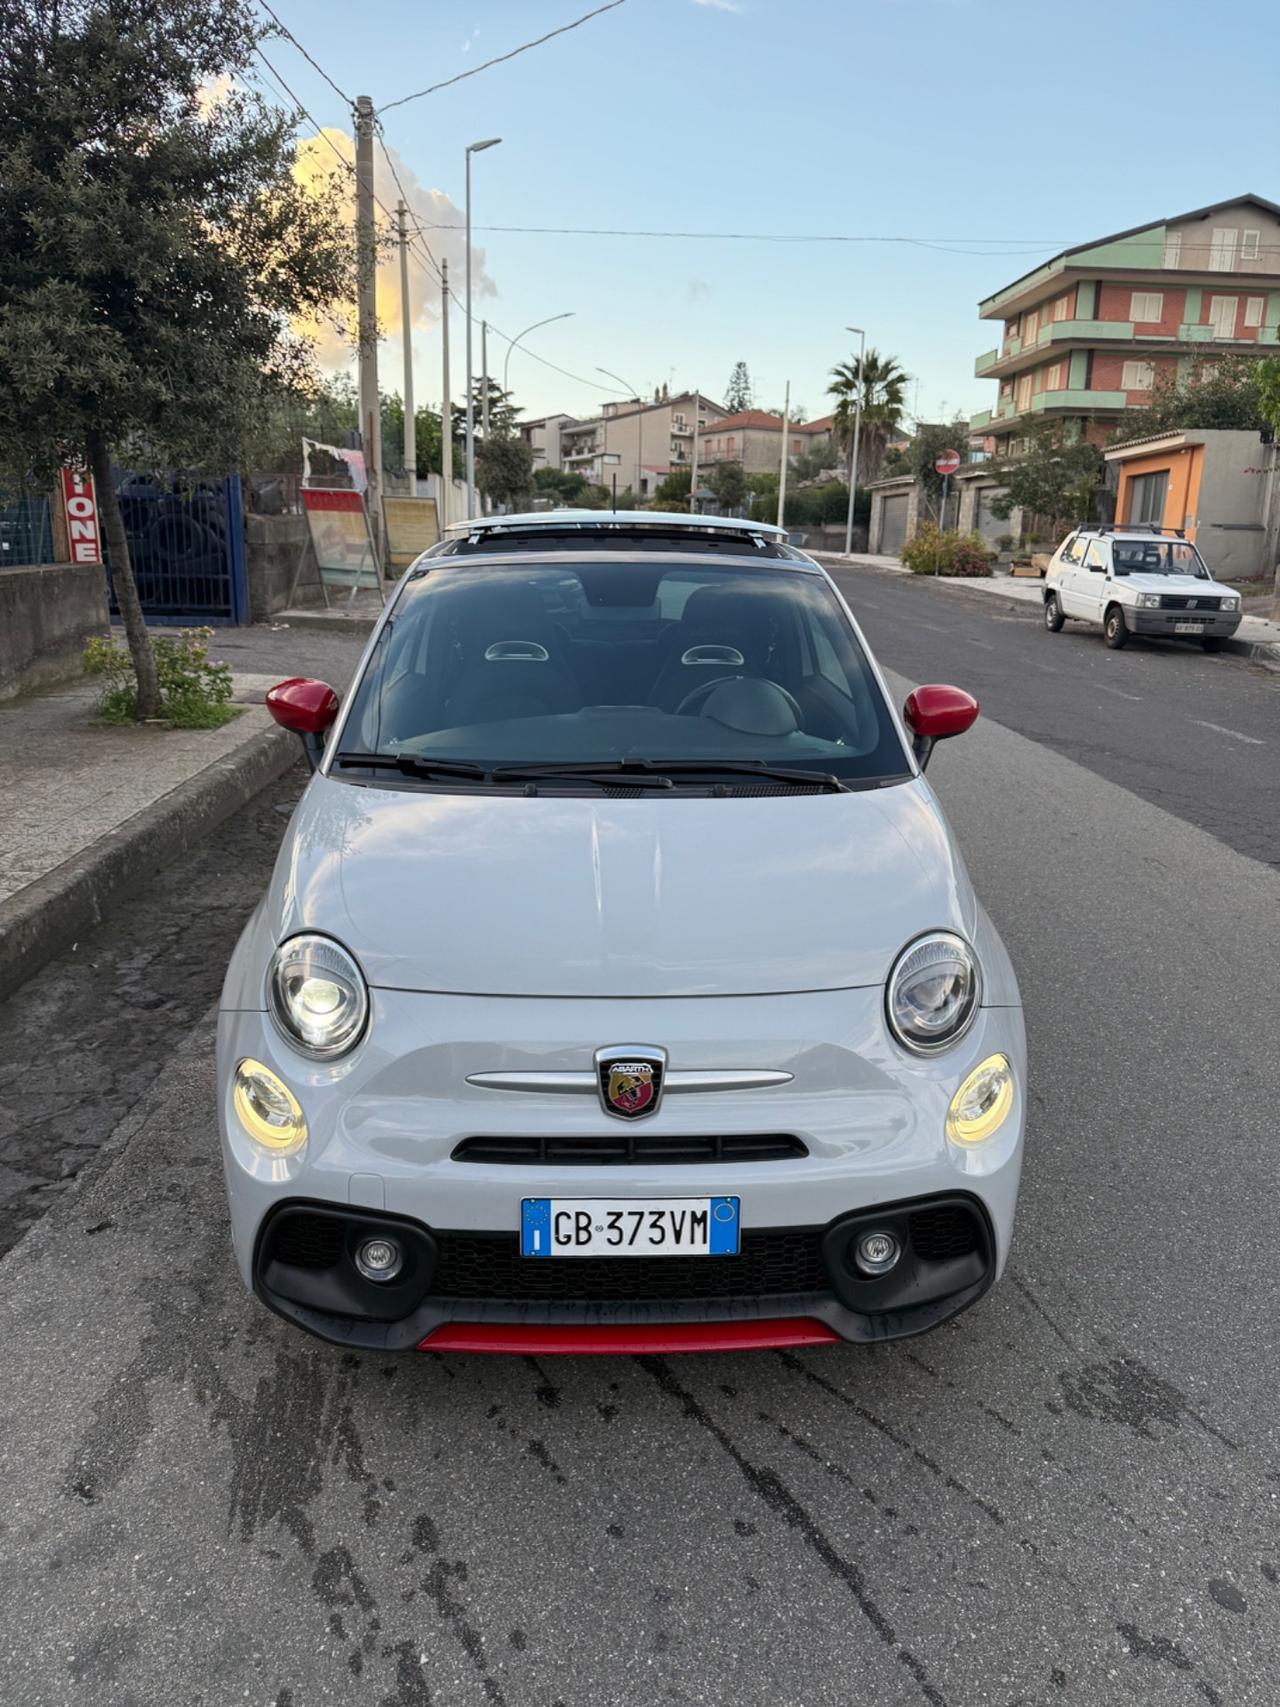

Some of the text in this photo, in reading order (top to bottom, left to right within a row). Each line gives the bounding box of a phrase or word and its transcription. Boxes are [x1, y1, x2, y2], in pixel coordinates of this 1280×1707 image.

[67, 460, 98, 562] IONE
[611, 1065, 650, 1073] ABARTH
[554, 1211, 593, 1246] GB
[606, 1210, 708, 1246] 373VM
